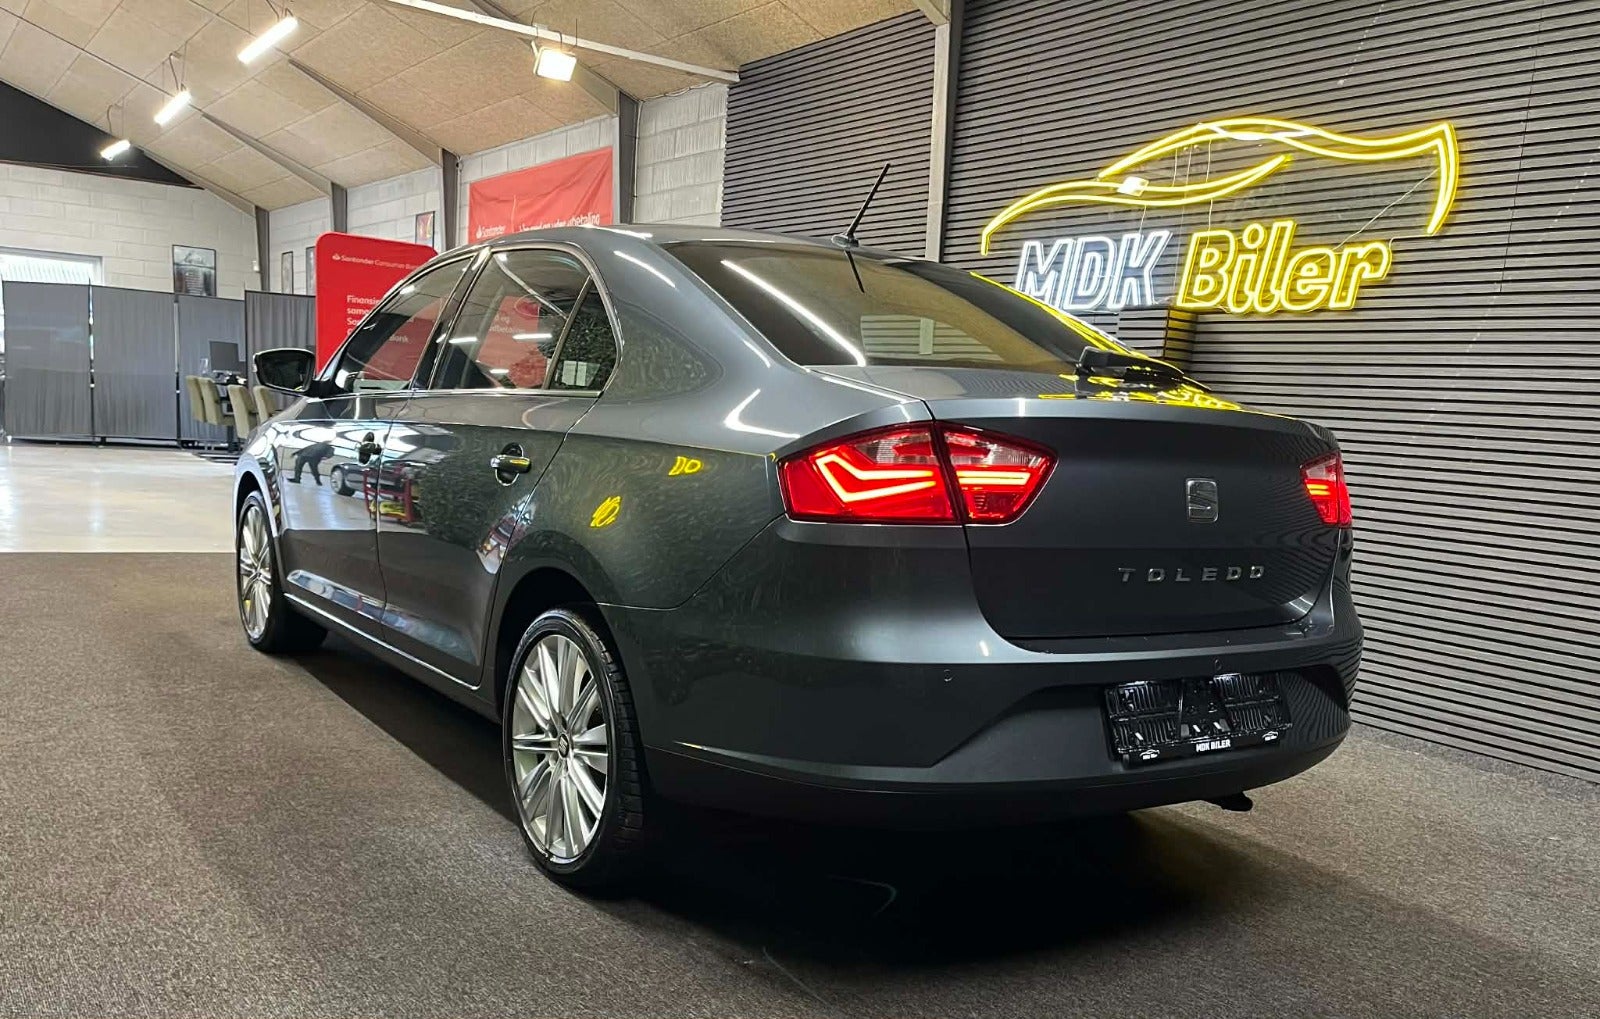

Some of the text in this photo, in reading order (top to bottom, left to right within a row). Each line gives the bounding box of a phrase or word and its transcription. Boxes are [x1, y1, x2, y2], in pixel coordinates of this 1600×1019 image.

[341, 255, 374, 265] Santander
[1015, 220, 1392, 314] MDK Biler
[1118, 565, 1266, 582] TOLEDO
